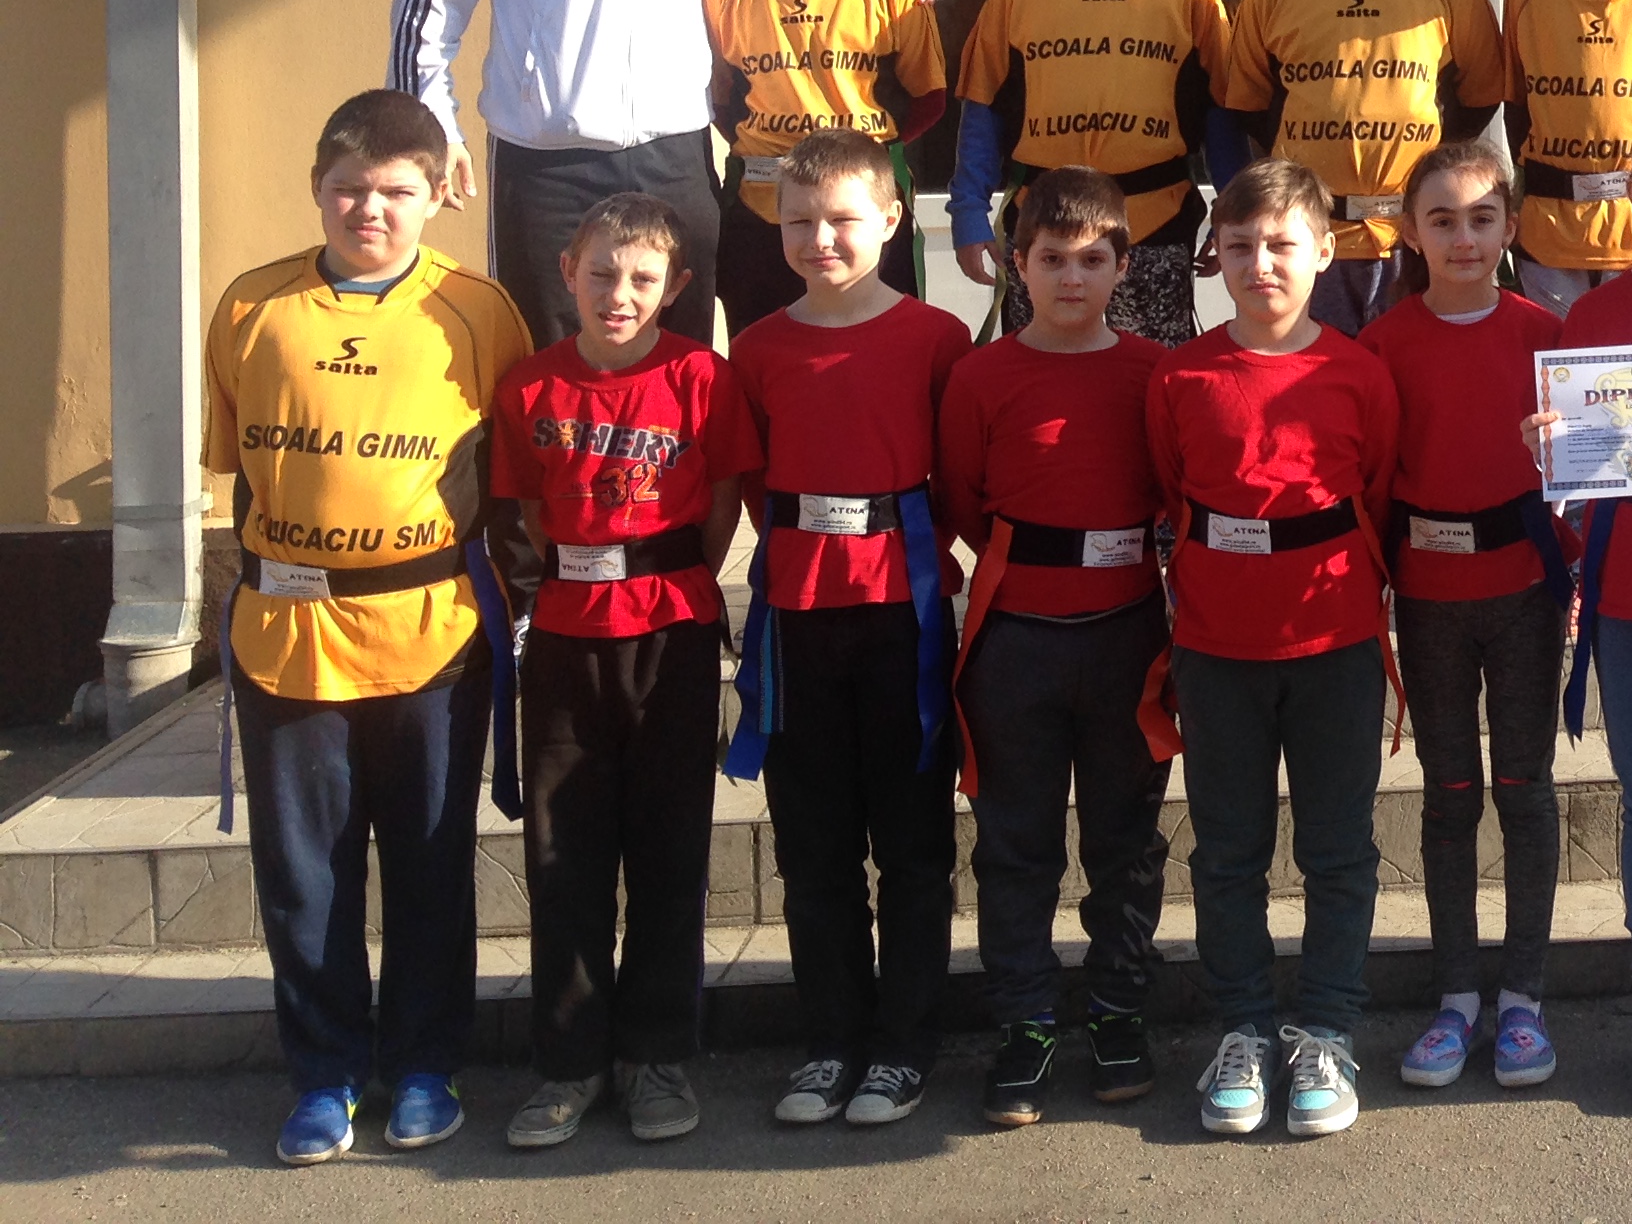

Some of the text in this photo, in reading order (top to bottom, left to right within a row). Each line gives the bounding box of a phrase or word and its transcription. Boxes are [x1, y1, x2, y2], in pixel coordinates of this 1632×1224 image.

[780, 14, 824, 25] salta
[1336, 8, 1380, 18] salta
[1025, 36, 1179, 64] SCOALA GIMN.
[1577, 36, 1614, 44] salta
[742, 51, 811, 75] SCOALA
[1284, 59, 1430, 83] SCOALA GIMN.
[1526, 75, 1604, 97] SCOALA
[860, 111, 888, 132] SM
[1028, 112, 1170, 139] V. LUCACIU SM
[1285, 120, 1434, 142] V. LUCACIU SM
[314, 359, 378, 376] salta
[356, 433, 441, 461] GIMN.
[600, 462, 660, 507] 32
[393, 519, 437, 550] SM
